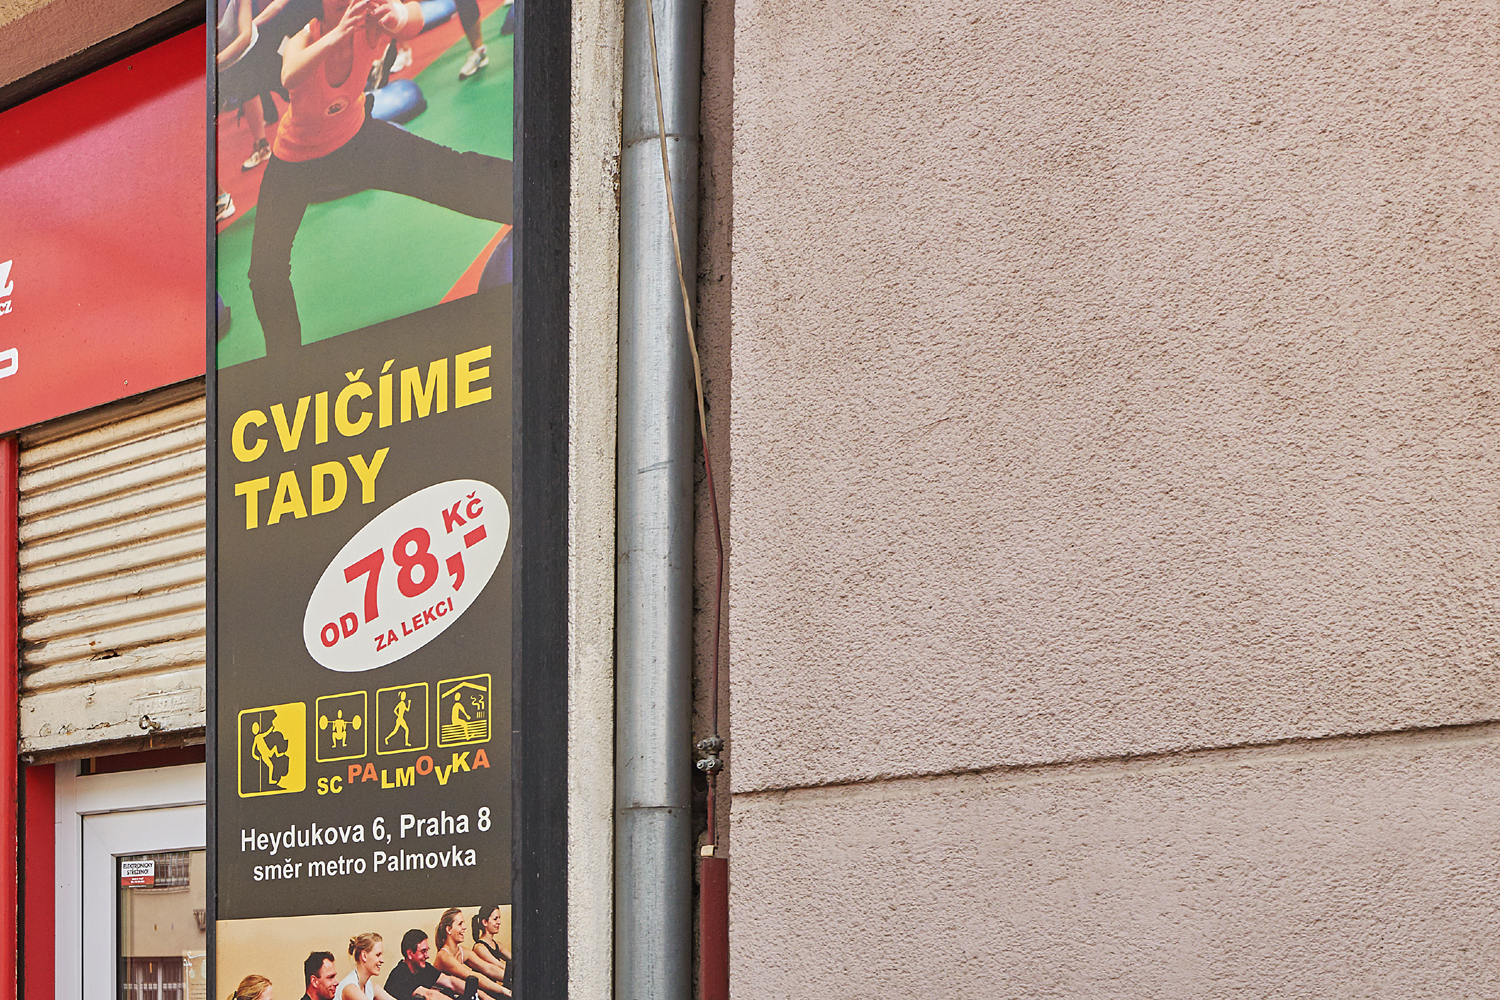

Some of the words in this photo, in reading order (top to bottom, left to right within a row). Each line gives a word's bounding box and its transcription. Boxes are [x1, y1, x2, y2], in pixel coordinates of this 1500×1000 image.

[231, 344, 492, 462] CVIČÍME
[234, 446, 390, 530] TADY
[320, 611, 359, 648] OD
[374, 629, 399, 652] ZA
[400, 597, 454, 637] LEKCI
[316, 775, 343, 796] SC
[347, 748, 491, 789] PALMOVKA
[240, 821, 365, 856] Heydukova
[372, 816, 392, 845] 6,
[400, 810, 470, 839] Praha
[477, 806, 491, 832] 8
[253, 857, 302, 882] směr
[308, 854, 367, 877] metro
[373, 844, 477, 873] Palmovka
